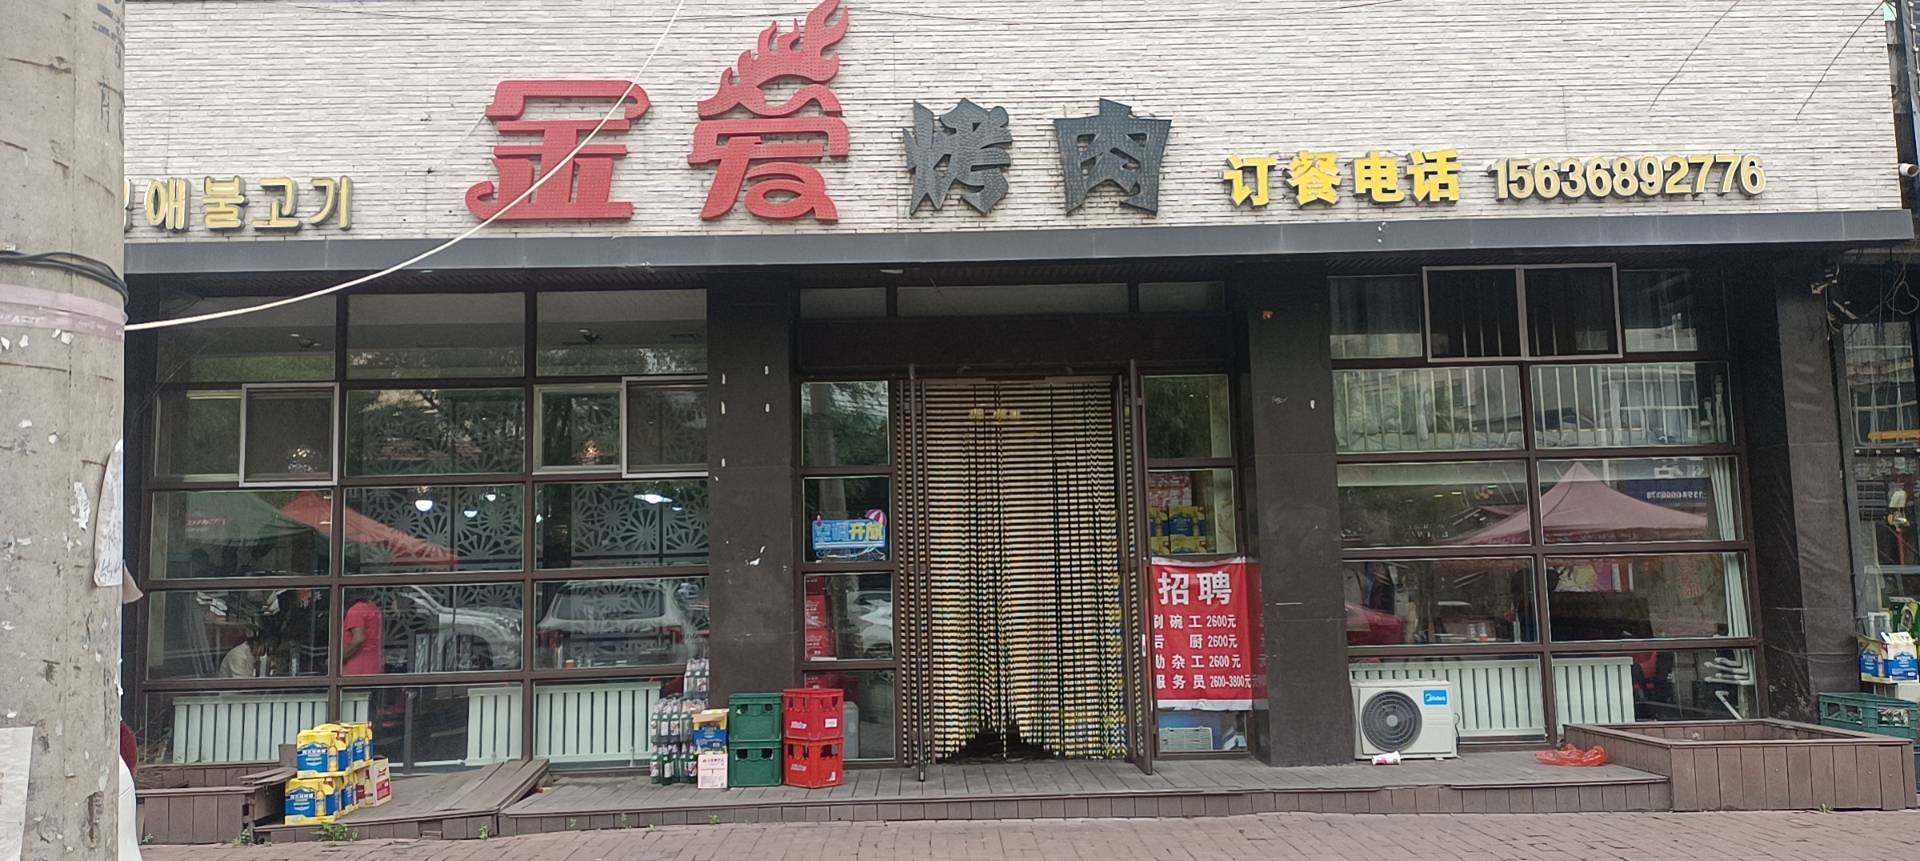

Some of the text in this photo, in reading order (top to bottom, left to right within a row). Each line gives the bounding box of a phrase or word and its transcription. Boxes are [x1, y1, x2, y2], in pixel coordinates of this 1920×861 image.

[1223, 150, 1767, 207] 订餐电话 15636892776
[124, 175, 352, 232] 애불고기
[1157, 571, 1232, 606] 招聘
[1206, 614, 1237, 628] 2600元
[1207, 634, 1238, 648] 2600元
[1156, 674, 1206, 690] 服务员
